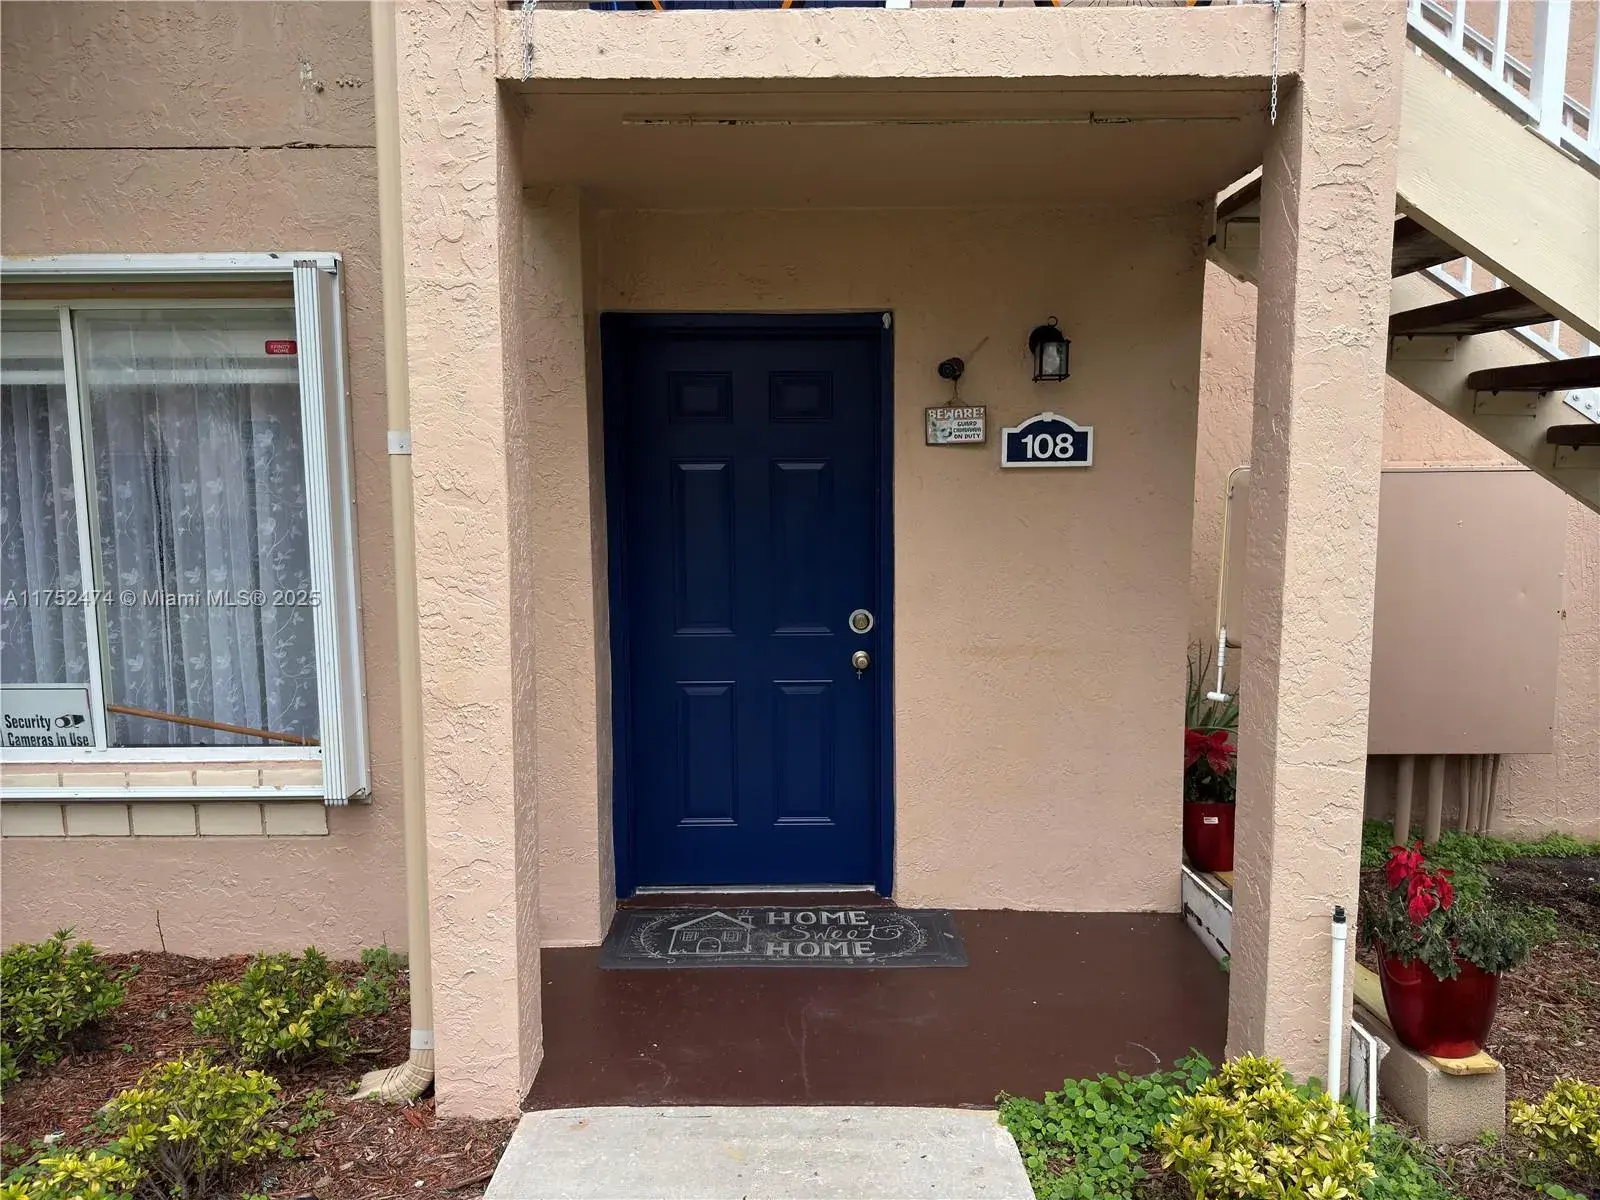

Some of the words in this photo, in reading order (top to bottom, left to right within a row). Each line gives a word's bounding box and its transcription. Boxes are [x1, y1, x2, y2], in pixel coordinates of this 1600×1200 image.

[929, 407, 984, 419] BEWARE!
[1021, 433, 1074, 459] 108
[4, 714, 51, 731] Security
[7, 732, 54, 747] Cameras
[69, 732, 90, 746] Use
[766, 911, 869, 925] HOME
[775, 924, 904, 941] Sweet
[765, 941, 876, 957] HOME
